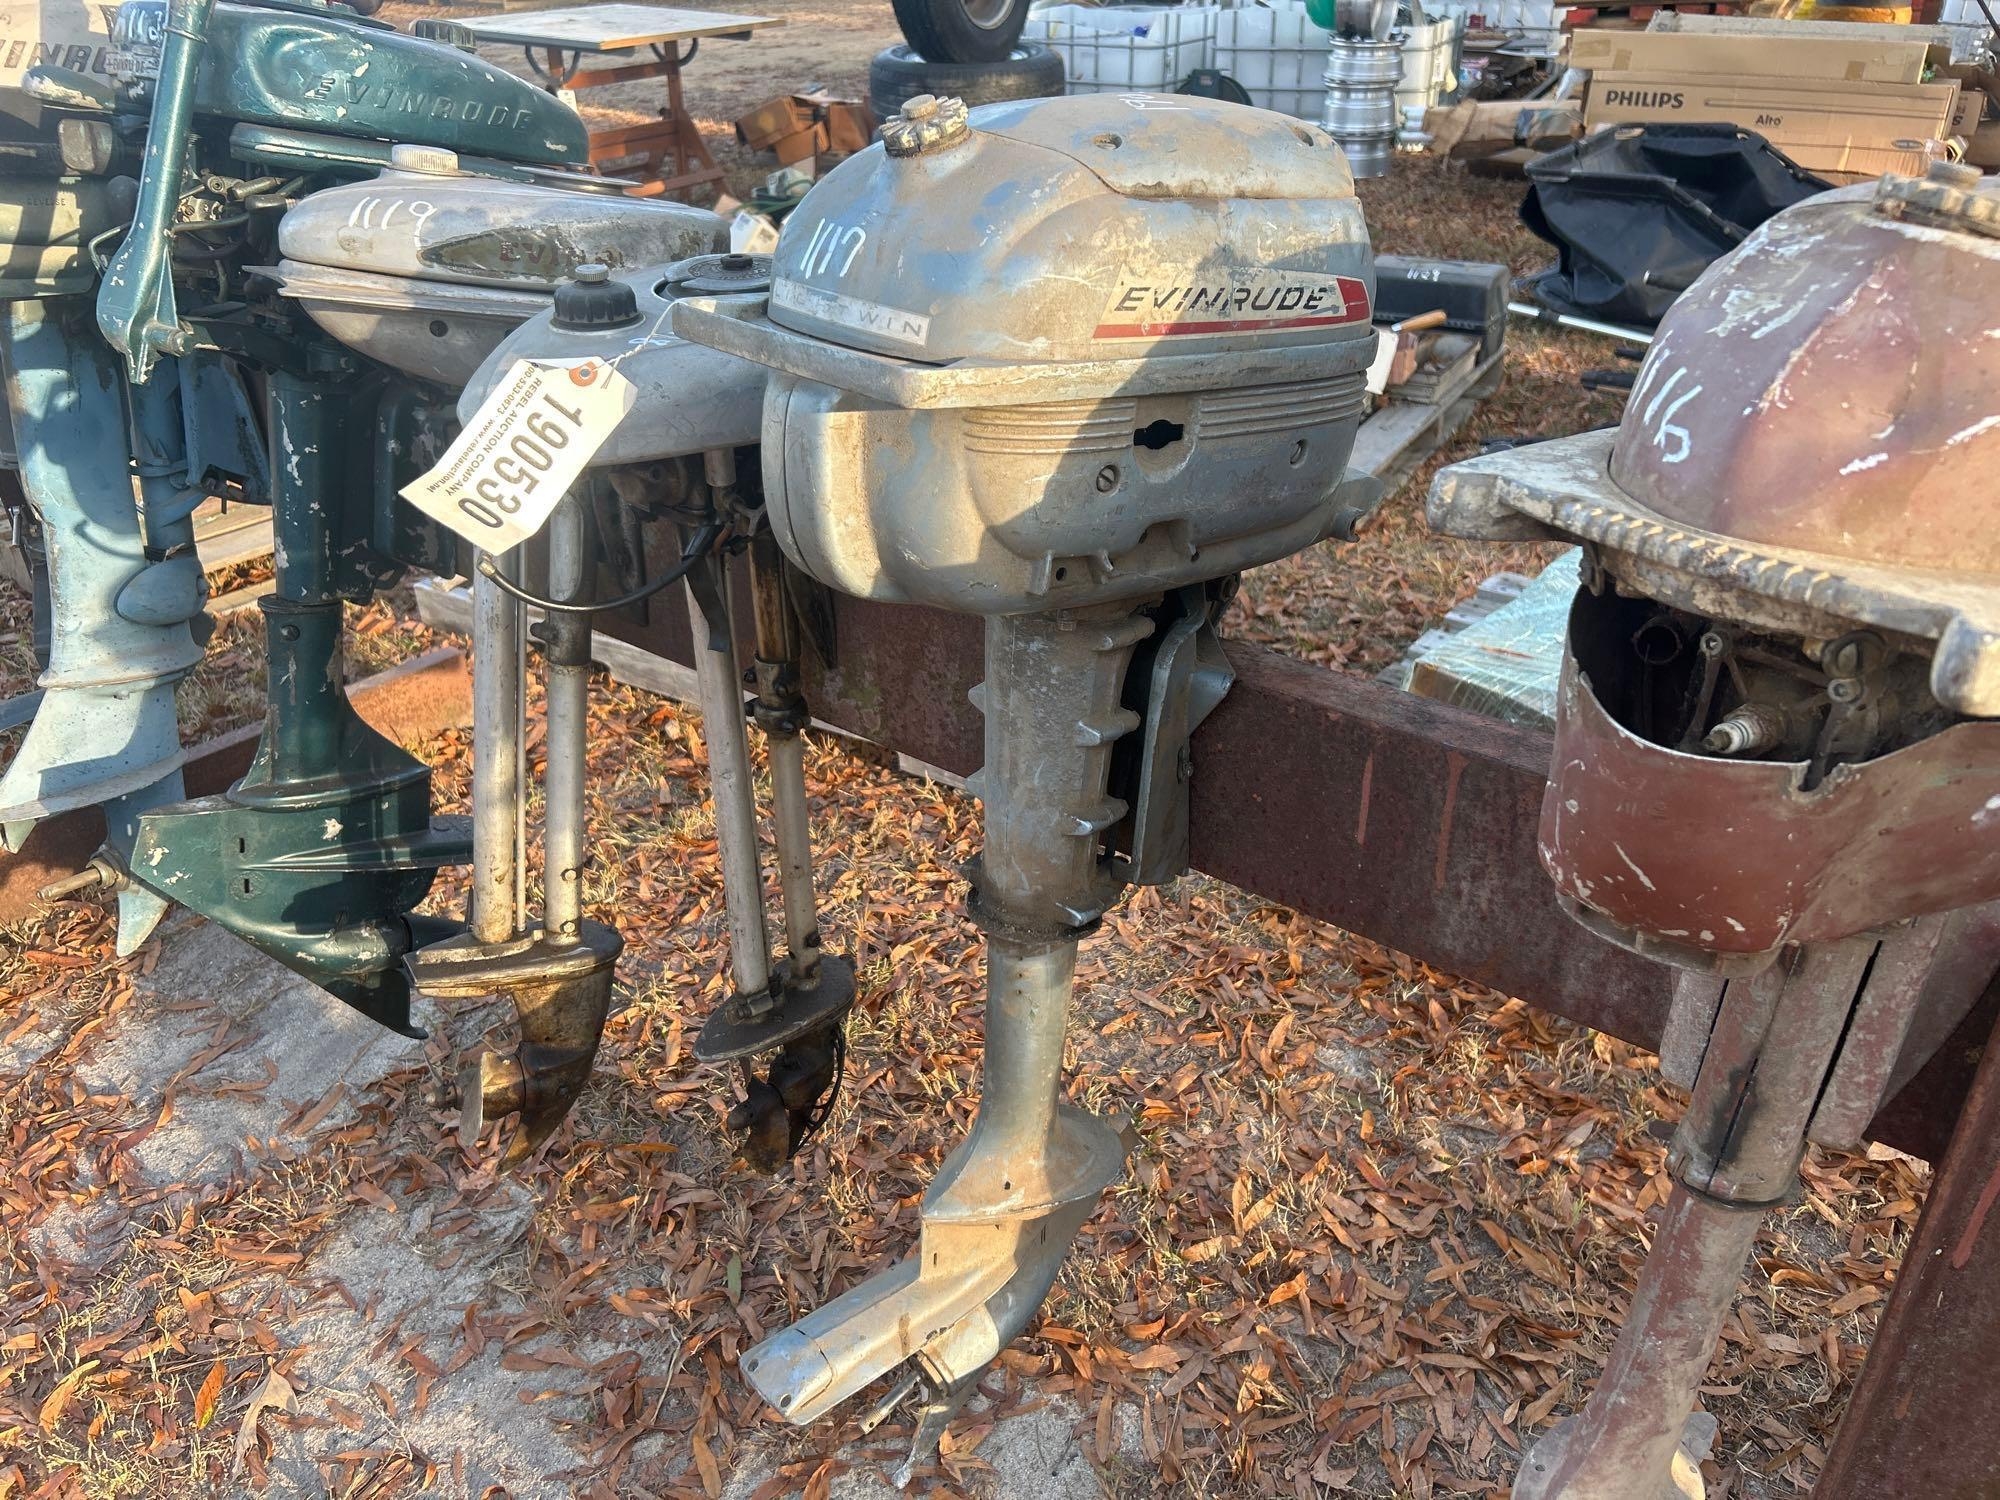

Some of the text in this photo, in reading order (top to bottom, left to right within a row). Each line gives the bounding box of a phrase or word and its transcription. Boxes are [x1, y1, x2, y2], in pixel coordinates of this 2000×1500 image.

[304, 77, 532, 129] EVINRUDE
[1605, 90, 1684, 109] PHILIPS
[349, 197, 438, 250] 1119
[800, 218, 867, 279] 1117
[1114, 286, 1330, 312] EVINRUDE
[426, 418, 495, 494] www.rebelauction.net
[446, 377, 542, 497] REBEL AUCTION COMPANY
[457, 393, 583, 528] 190530
